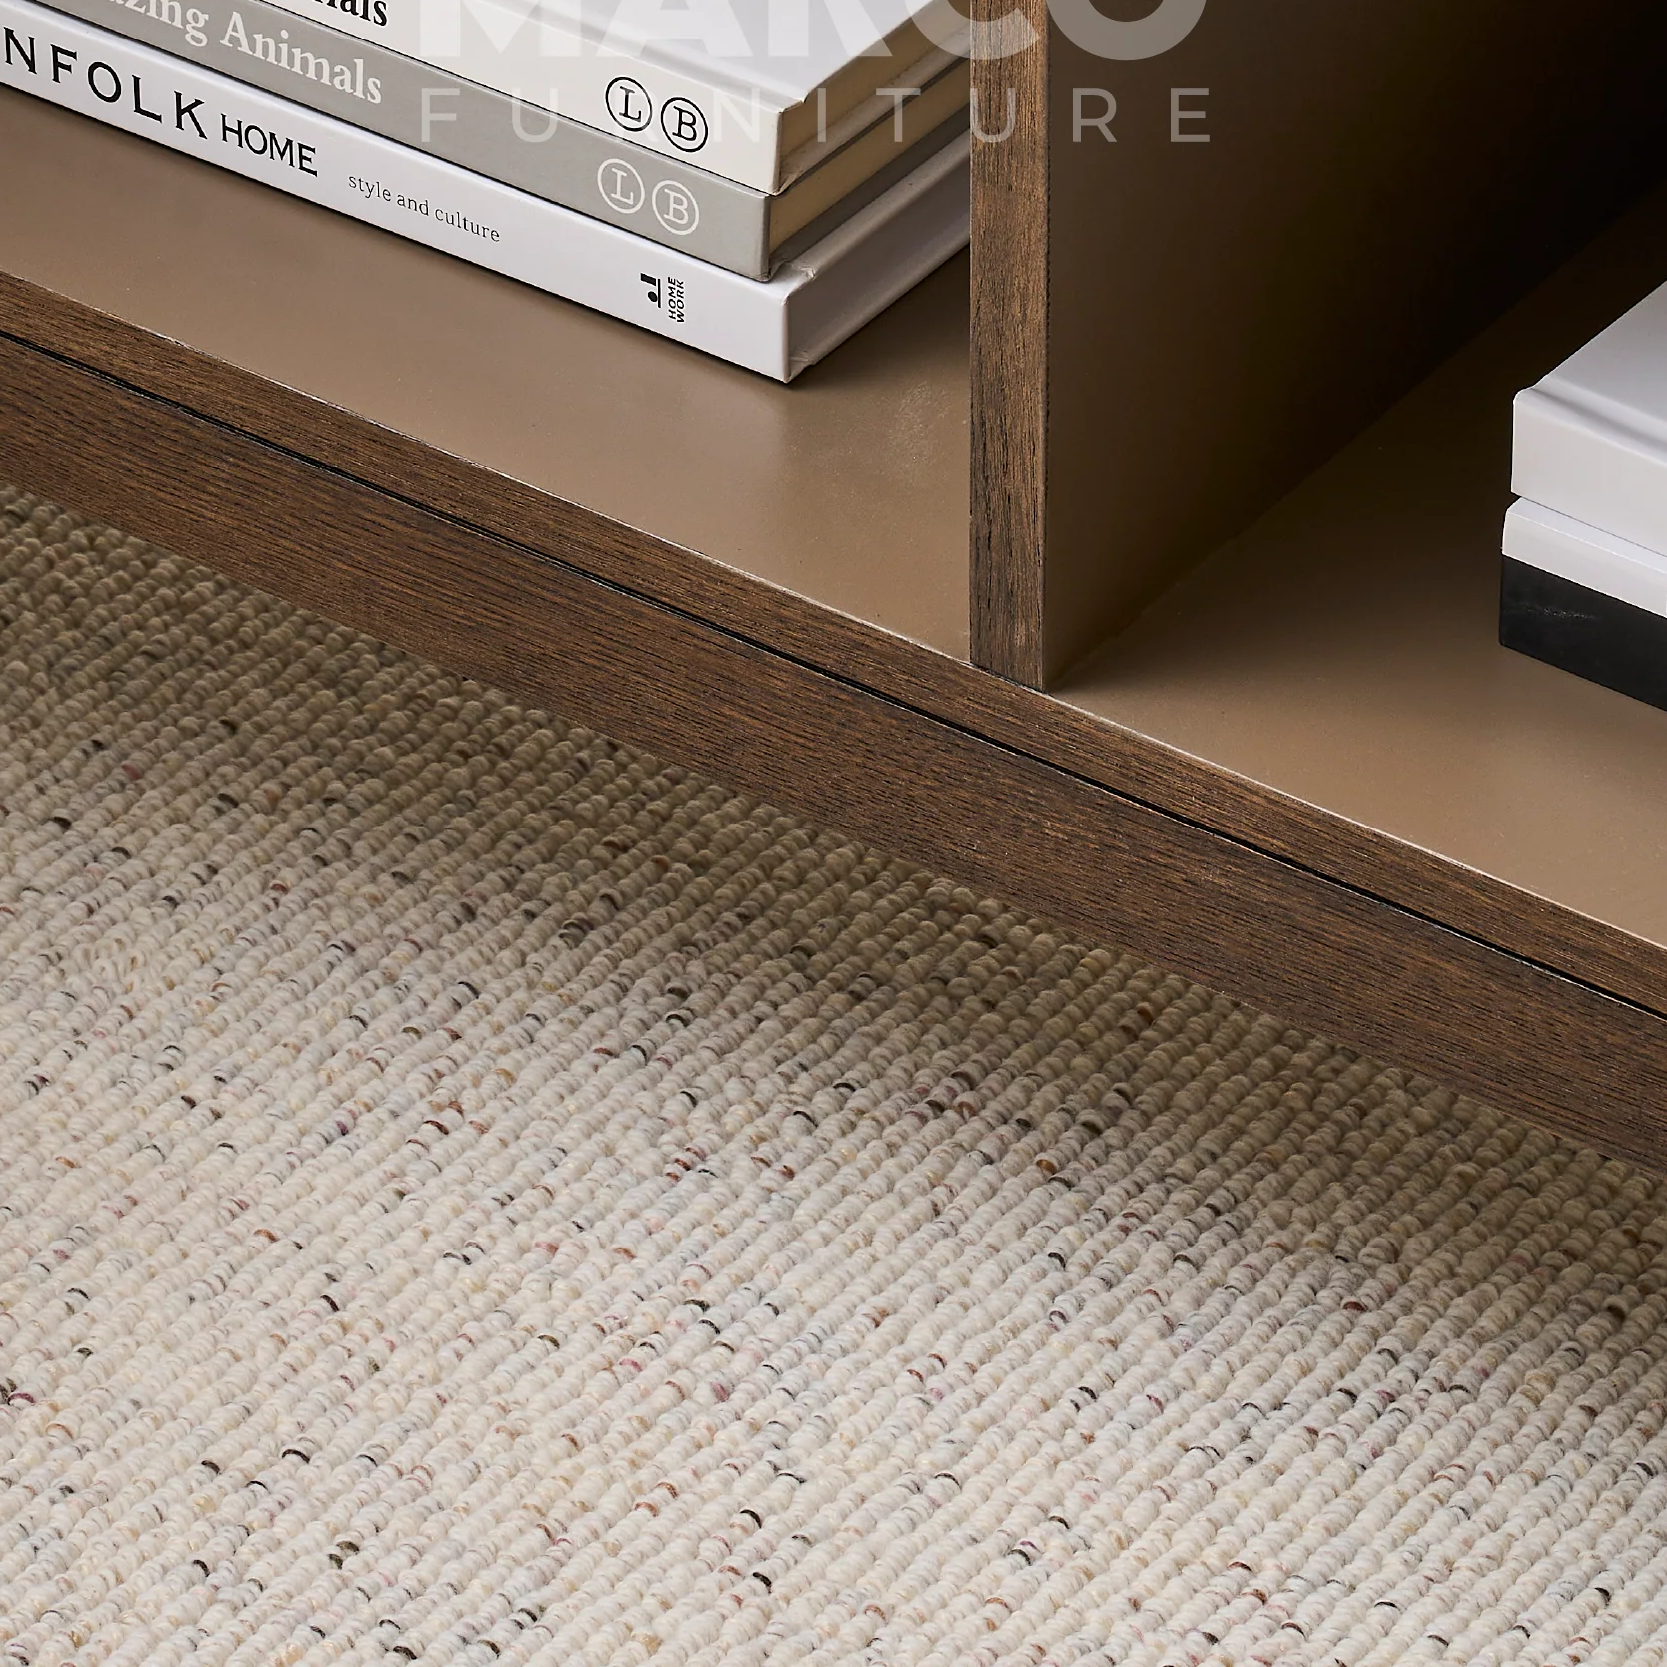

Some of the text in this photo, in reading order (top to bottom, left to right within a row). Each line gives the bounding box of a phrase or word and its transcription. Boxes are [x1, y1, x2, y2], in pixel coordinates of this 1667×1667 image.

[220, 12, 383, 103] Animals
[221, 113, 317, 177] HOME
[348, 176, 501, 243] style and culture
[668, 276, 677, 320] HOME
[676, 279, 685, 323] WORK
